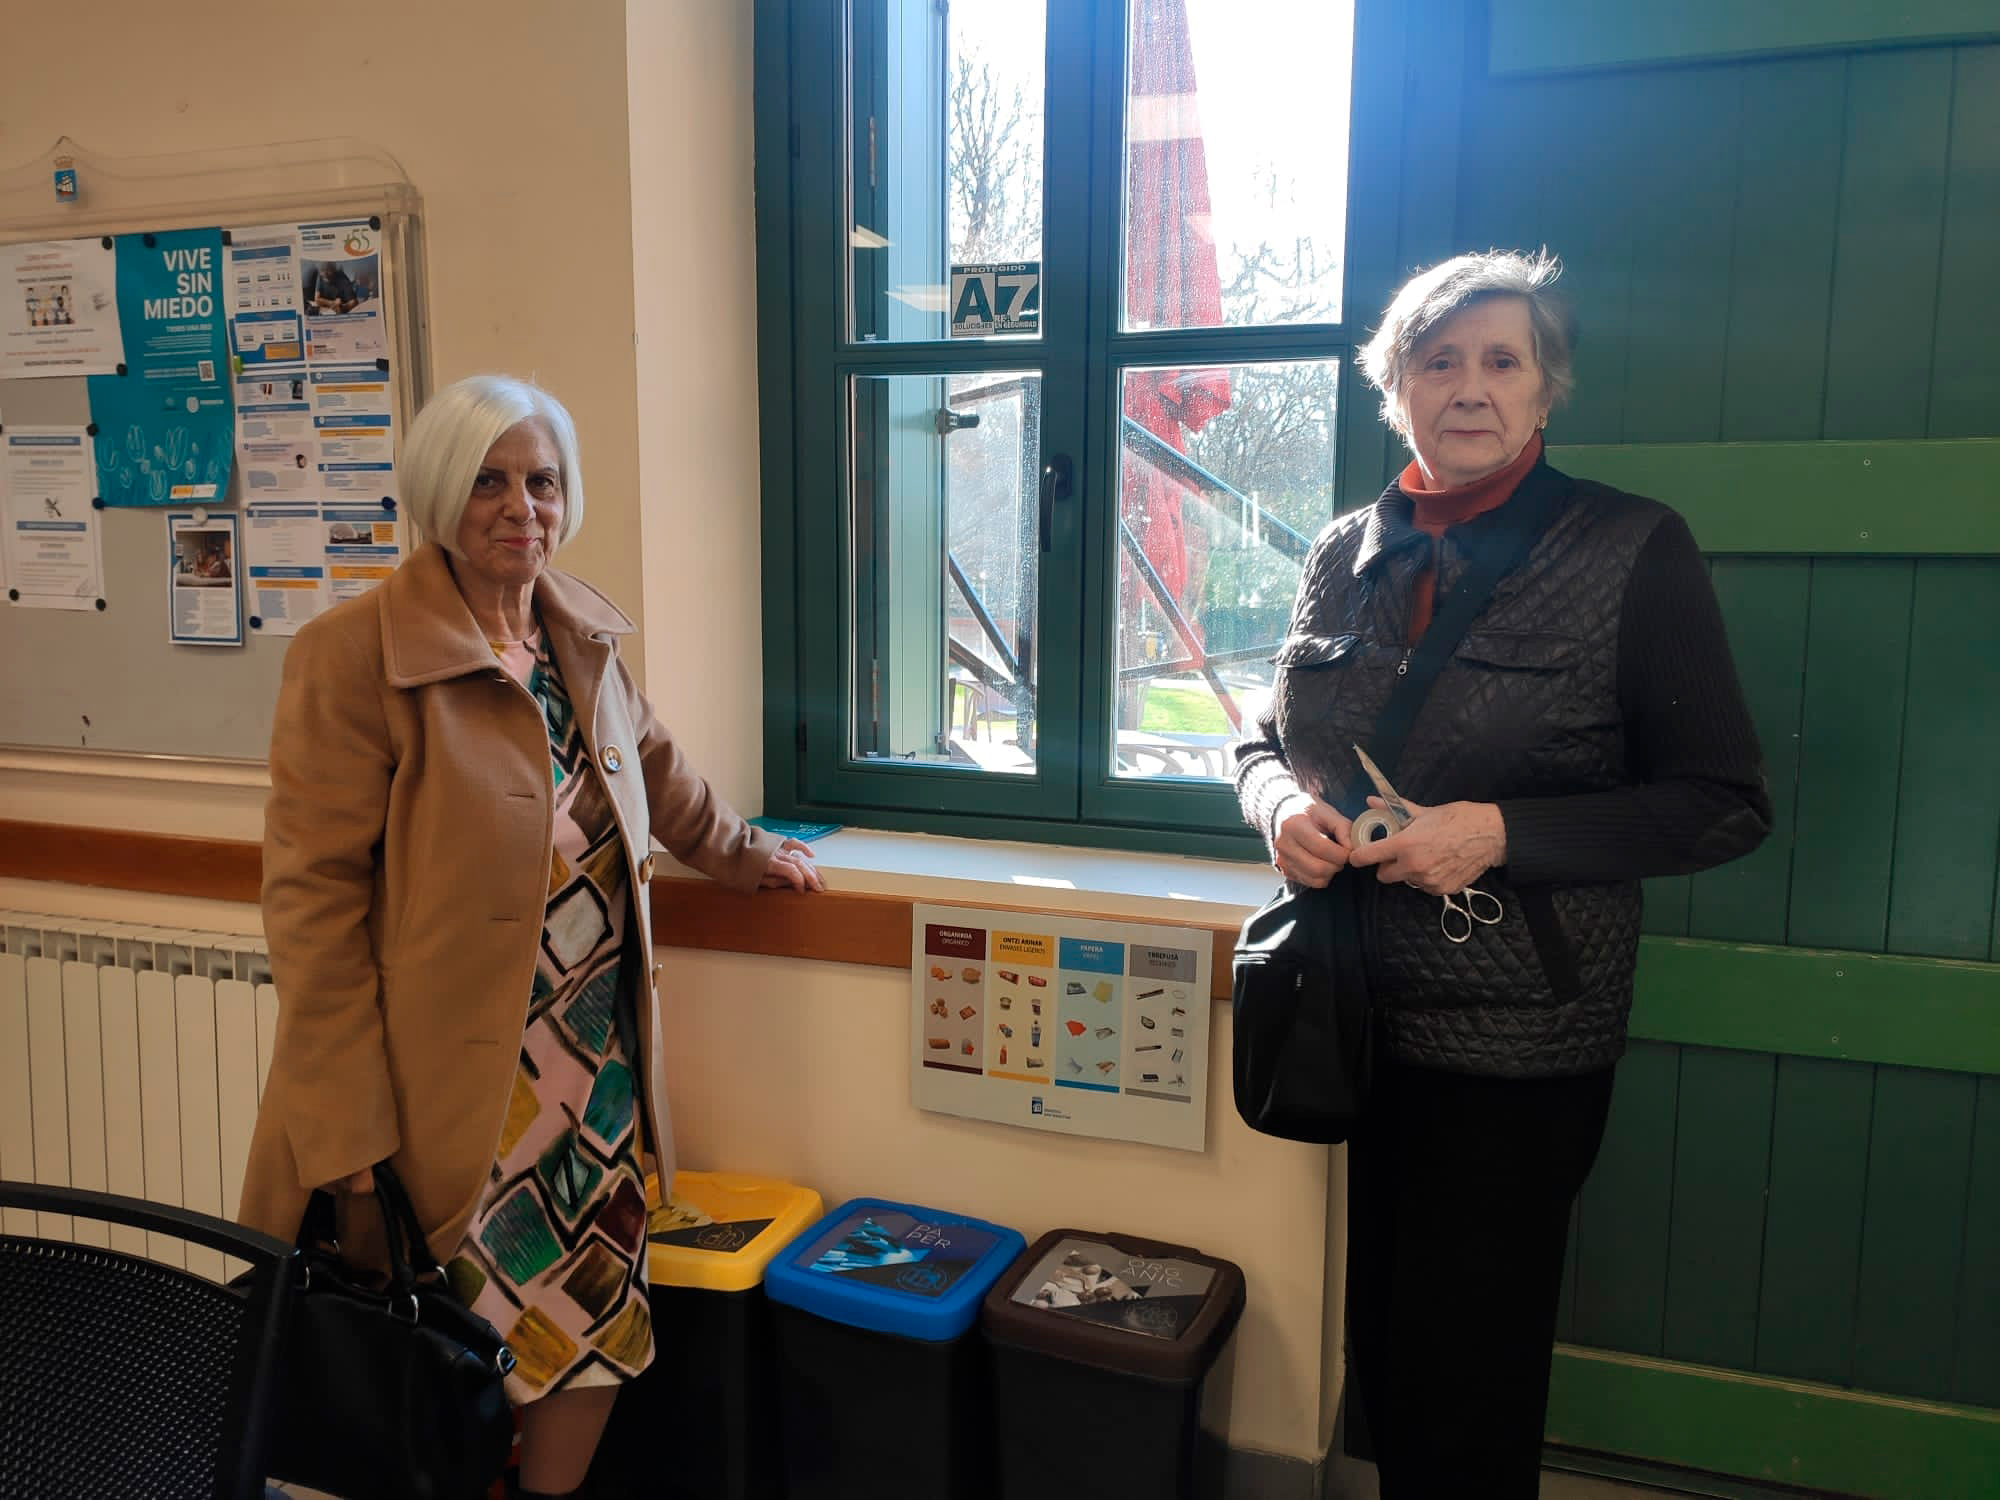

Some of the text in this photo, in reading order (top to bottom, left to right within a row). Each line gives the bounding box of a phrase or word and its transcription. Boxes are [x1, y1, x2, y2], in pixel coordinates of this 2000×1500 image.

[162, 247, 212, 272] VIVE
[963, 265, 1027, 273] PROTEGIDO
[176, 272, 212, 295] SIN
[144, 296, 214, 320] MIEDO
[953, 274, 1038, 324] A7
[905, 1231, 951, 1248] PER
